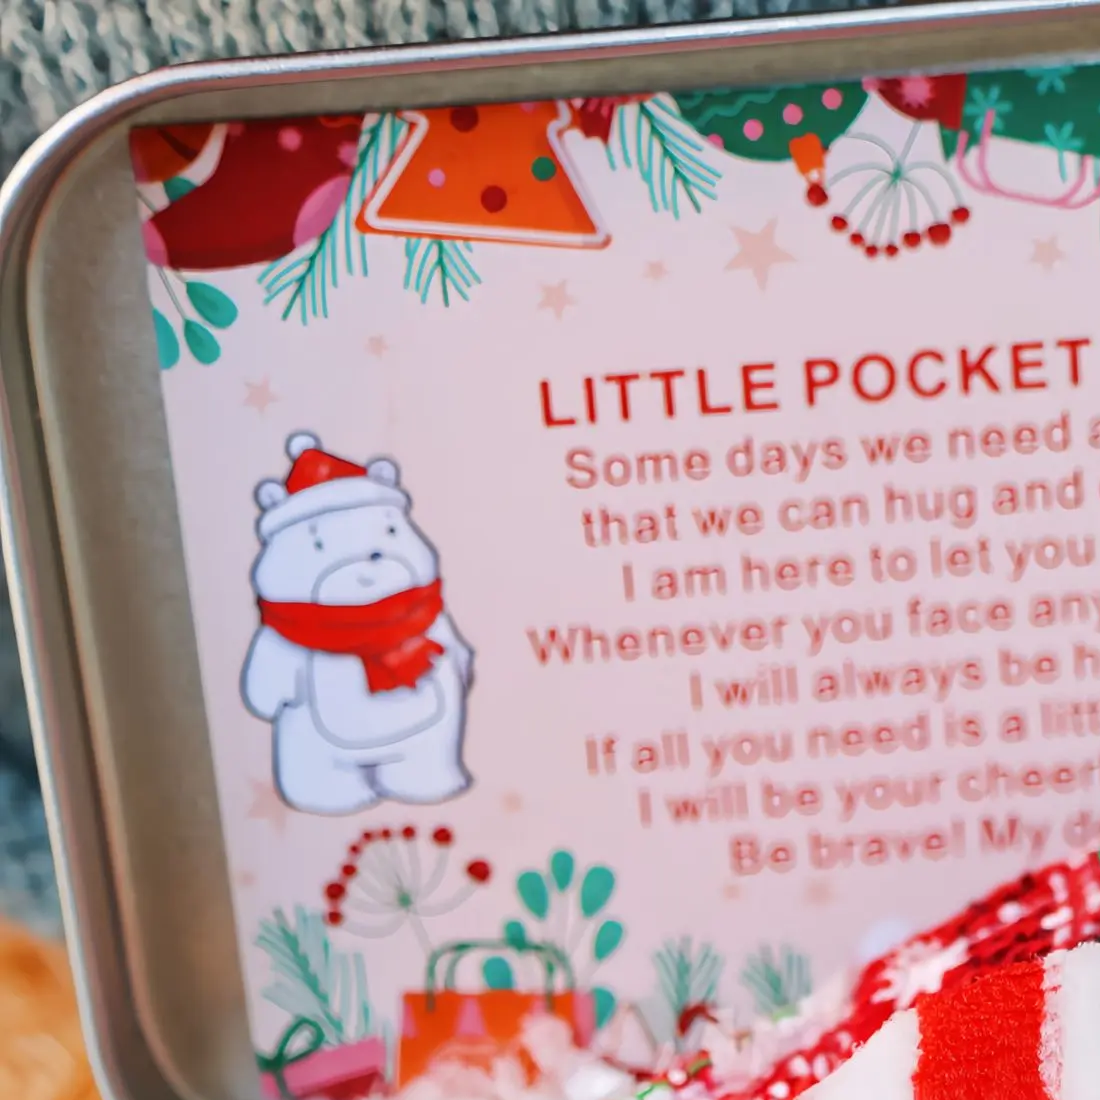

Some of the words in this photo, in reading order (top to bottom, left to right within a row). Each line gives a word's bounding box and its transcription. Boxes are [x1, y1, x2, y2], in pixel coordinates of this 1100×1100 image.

[540, 362, 780, 428] LITTLE
[804, 337, 1092, 407] POCKET
[564, 446, 711, 489] Some
[726, 436, 848, 483] days
[861, 431, 932, 463] we
[947, 410, 1072, 459] need
[581, 503, 679, 548] that
[692, 504, 765, 537] we
[778, 493, 870, 532] can
[883, 482, 977, 529] hug
[992, 466, 1084, 516] and
[622, 562, 636, 602] I
[651, 565, 727, 600] am
[741, 552, 856, 592] here
[869, 544, 918, 583] to
[929, 534, 994, 578] let
[1005, 534, 1096, 582] you
[526, 616, 789, 665] Whenever
[803, 609, 893, 656] you
[907, 596, 1014, 637] face
[689, 669, 703, 712] I
[714, 663, 798, 709] will
[812, 656, 986, 702] always
[998, 648, 1060, 687] be
[584, 730, 618, 776] If
[631, 728, 690, 774] all
[700, 728, 793, 777] you
[805, 711, 931, 760] need
[942, 707, 986, 746] is
[998, 705, 1028, 743] a
[637, 786, 652, 829] I
[663, 779, 749, 826] will
[760, 775, 824, 818] be
[833, 771, 945, 822] your
[729, 832, 799, 876] Be
[980, 815, 1052, 859] My
